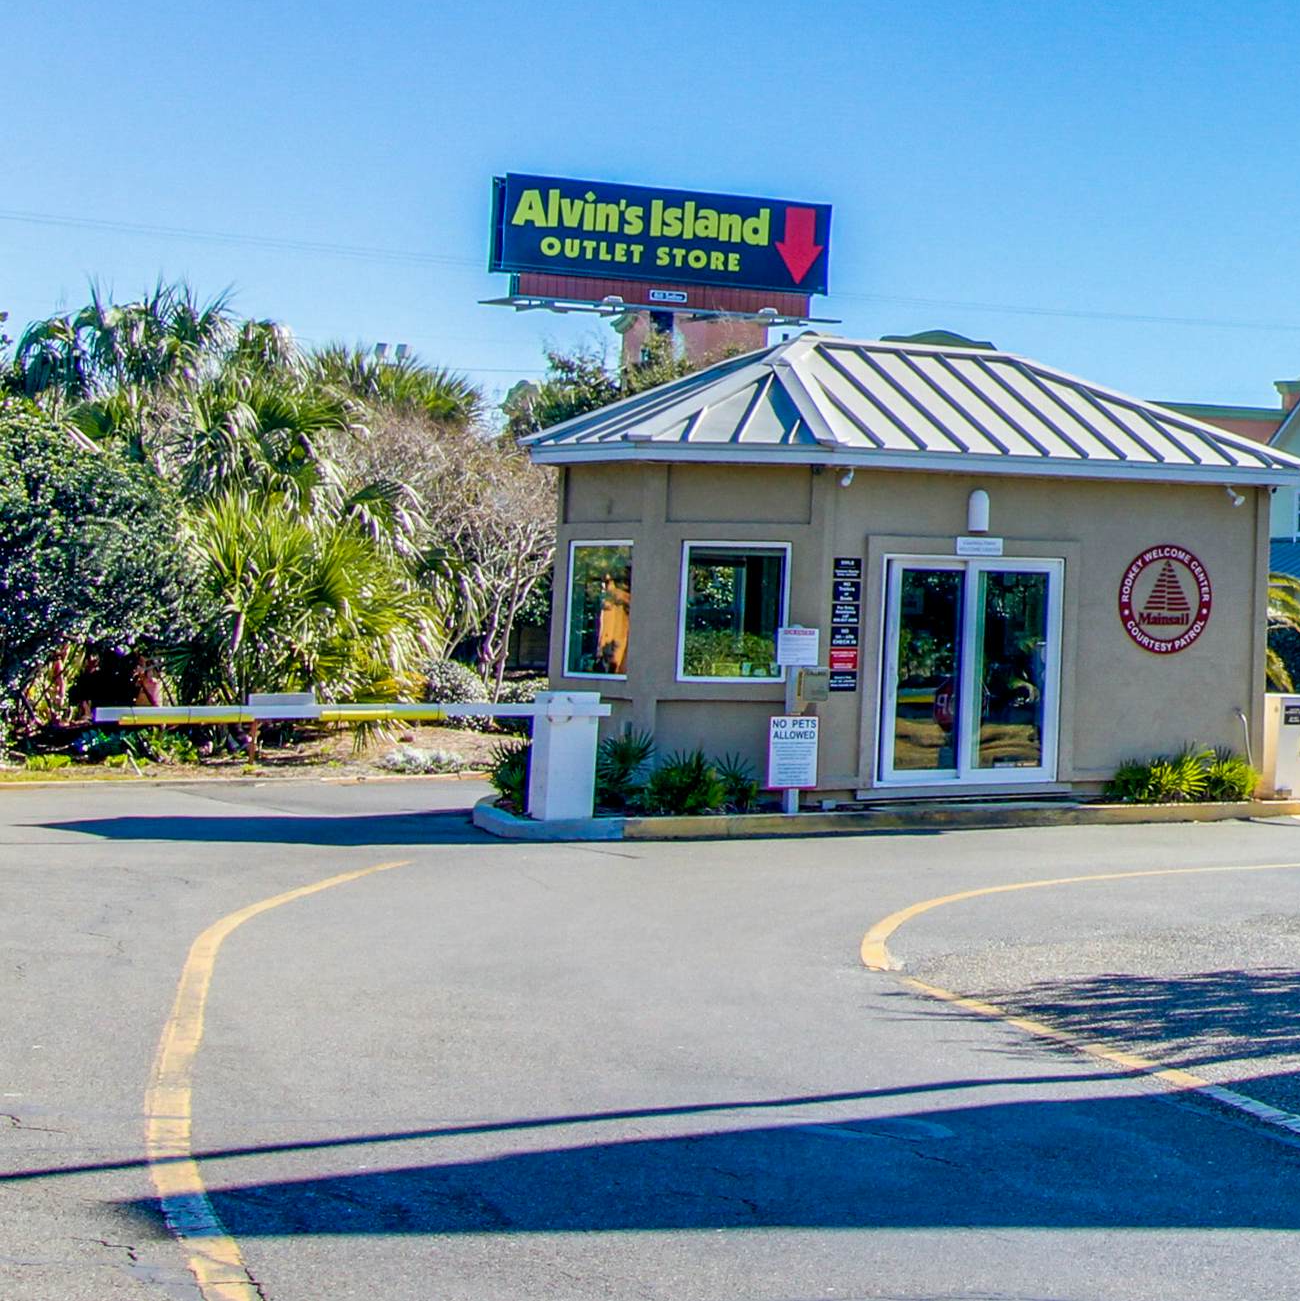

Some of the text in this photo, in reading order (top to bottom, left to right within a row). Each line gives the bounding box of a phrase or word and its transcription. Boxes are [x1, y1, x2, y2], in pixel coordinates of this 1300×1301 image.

[511, 187, 771, 246] Alvin's Island
[540, 237, 741, 272] OUTLET STORE
[1121, 547, 1210, 602] RODKEY WELCOME CENTER
[1138, 612, 1190, 626] Mainsail
[1127, 620, 1205, 652] COURTESY PATROL
[772, 719, 817, 729] NO PETS
[773, 730, 816, 740] ALLOWED
